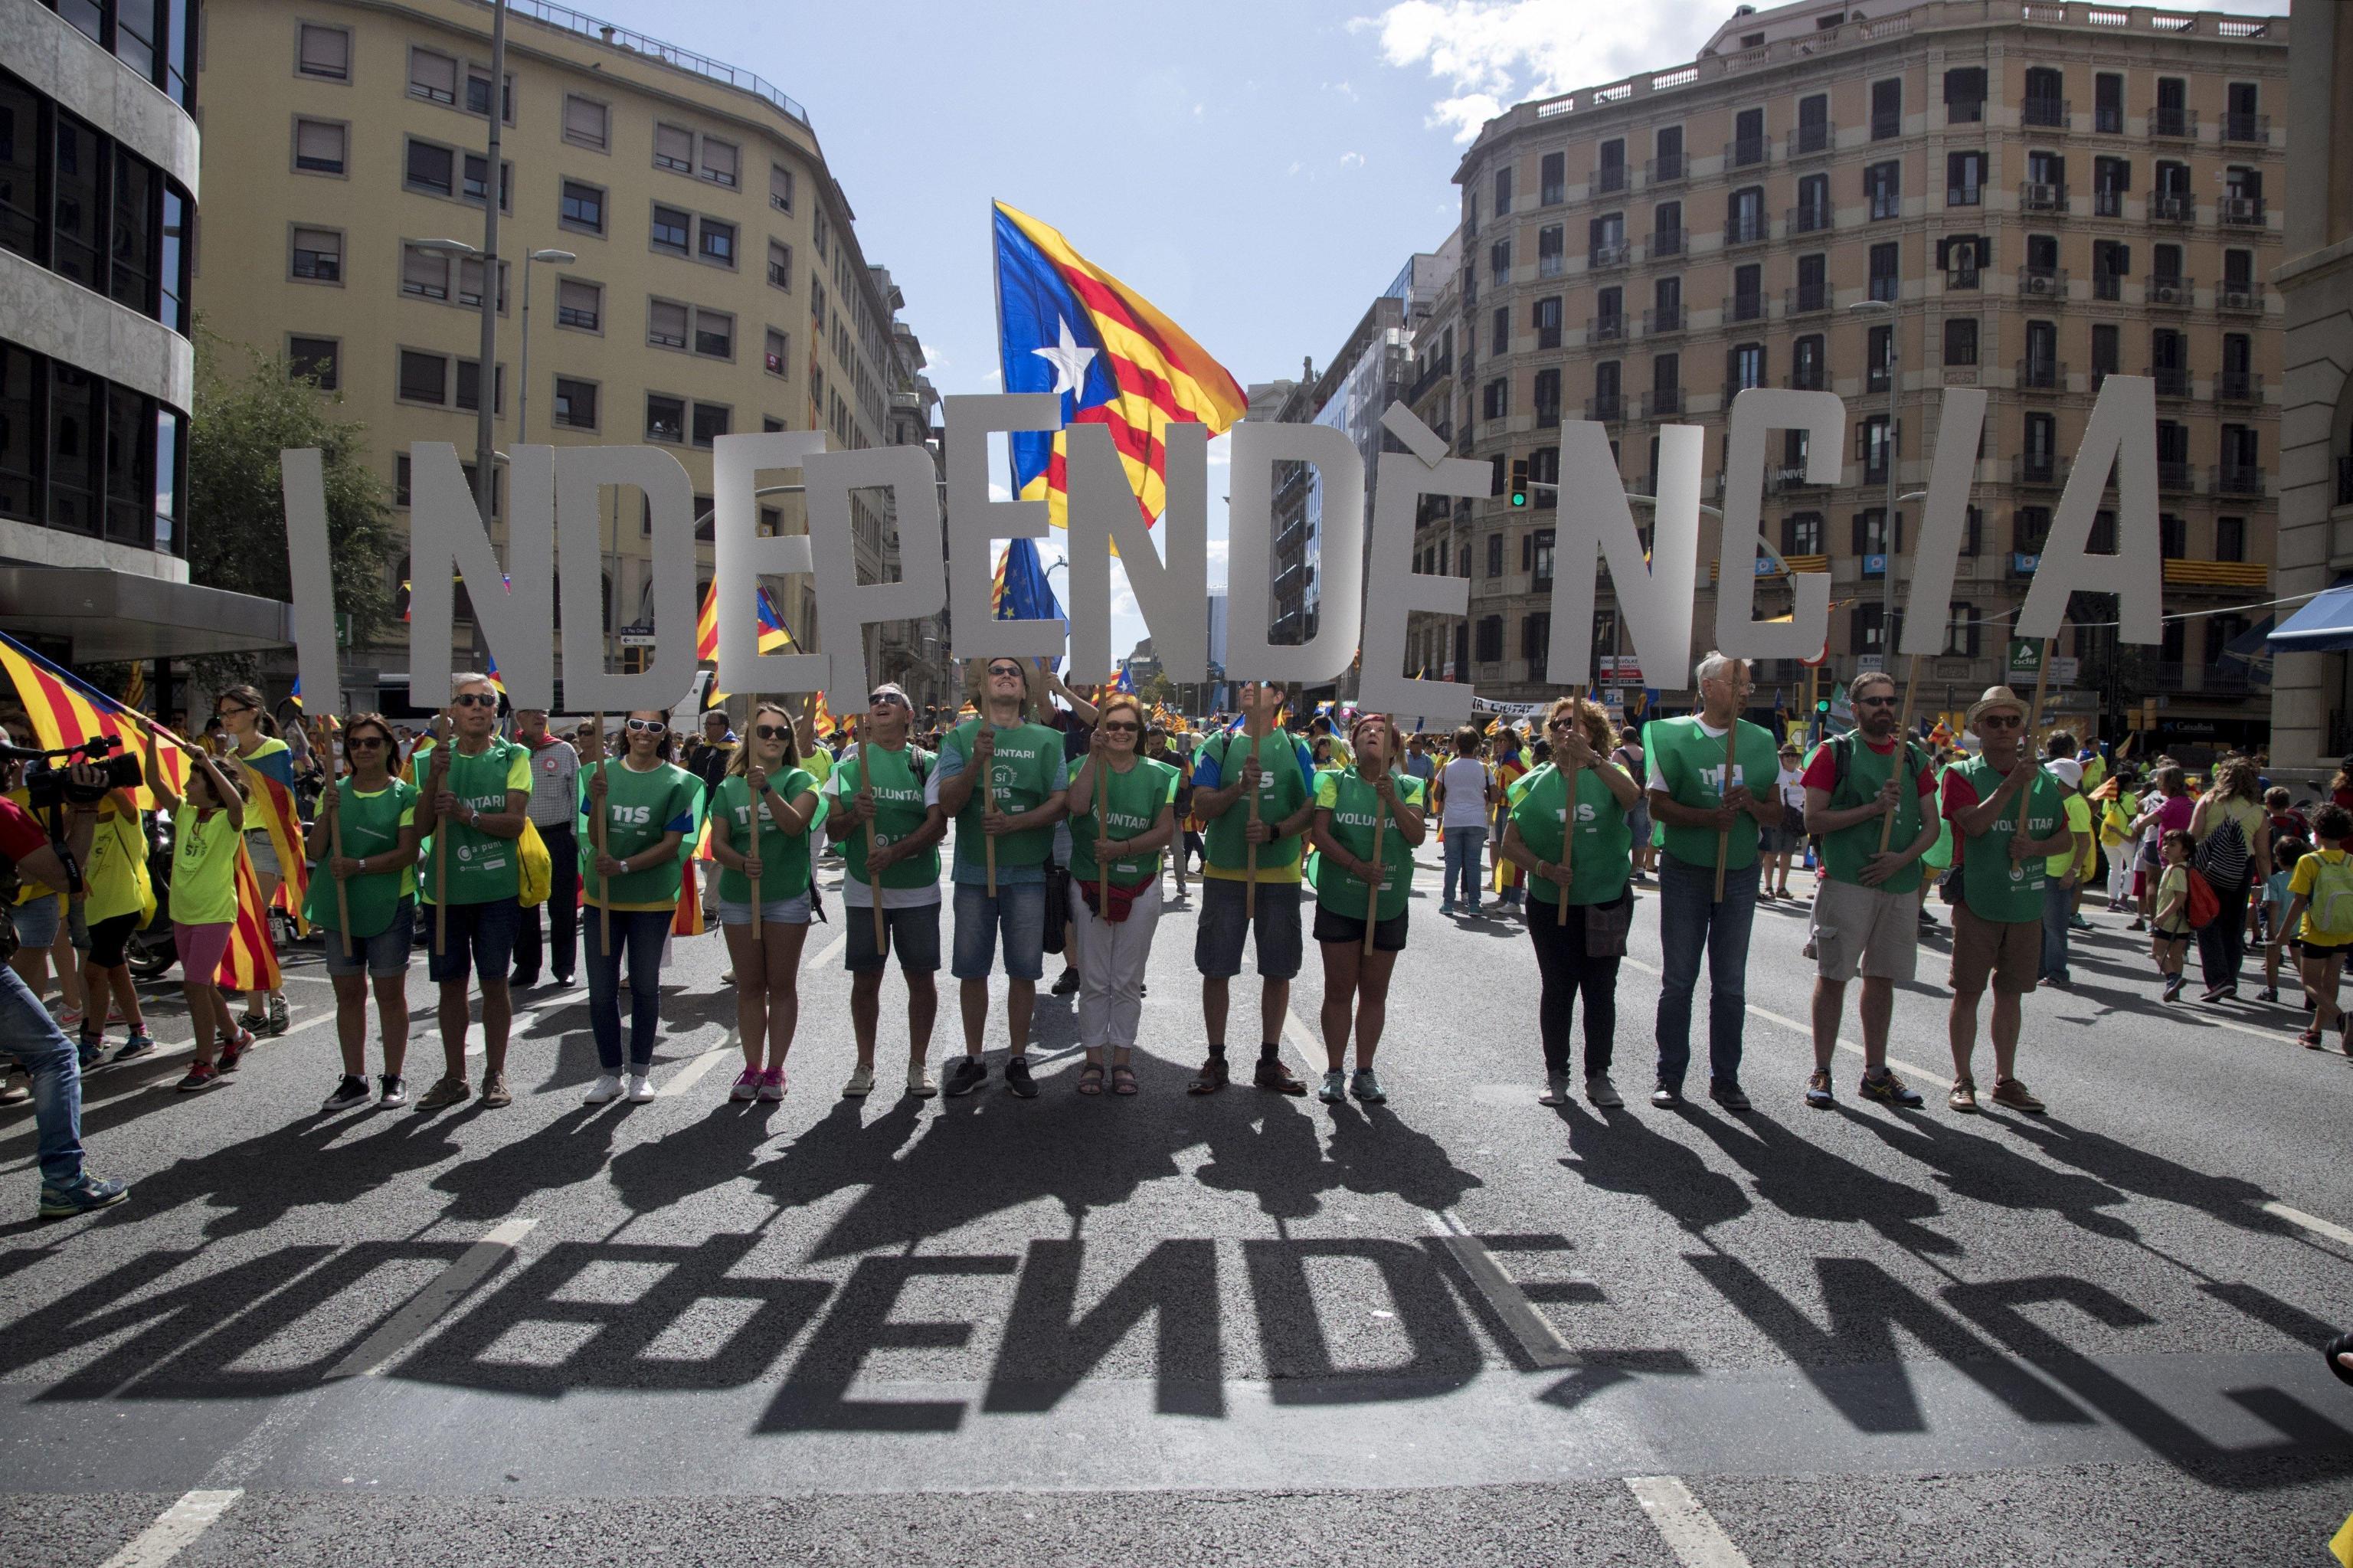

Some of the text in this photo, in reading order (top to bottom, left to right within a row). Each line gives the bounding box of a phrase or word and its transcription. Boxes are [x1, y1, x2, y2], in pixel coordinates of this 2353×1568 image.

[281, 374, 2163, 720] INDEPENDÈNCIA
[1490, 702, 1534, 714] CIUTAT
[2176, 721, 2214, 732] CaixaBank
[995, 772, 1007, 782] Sí
[613, 804, 650, 824] 11S
[1991, 817, 2054, 832] VOLNTAR
[67, 859, 79, 878] SONY
